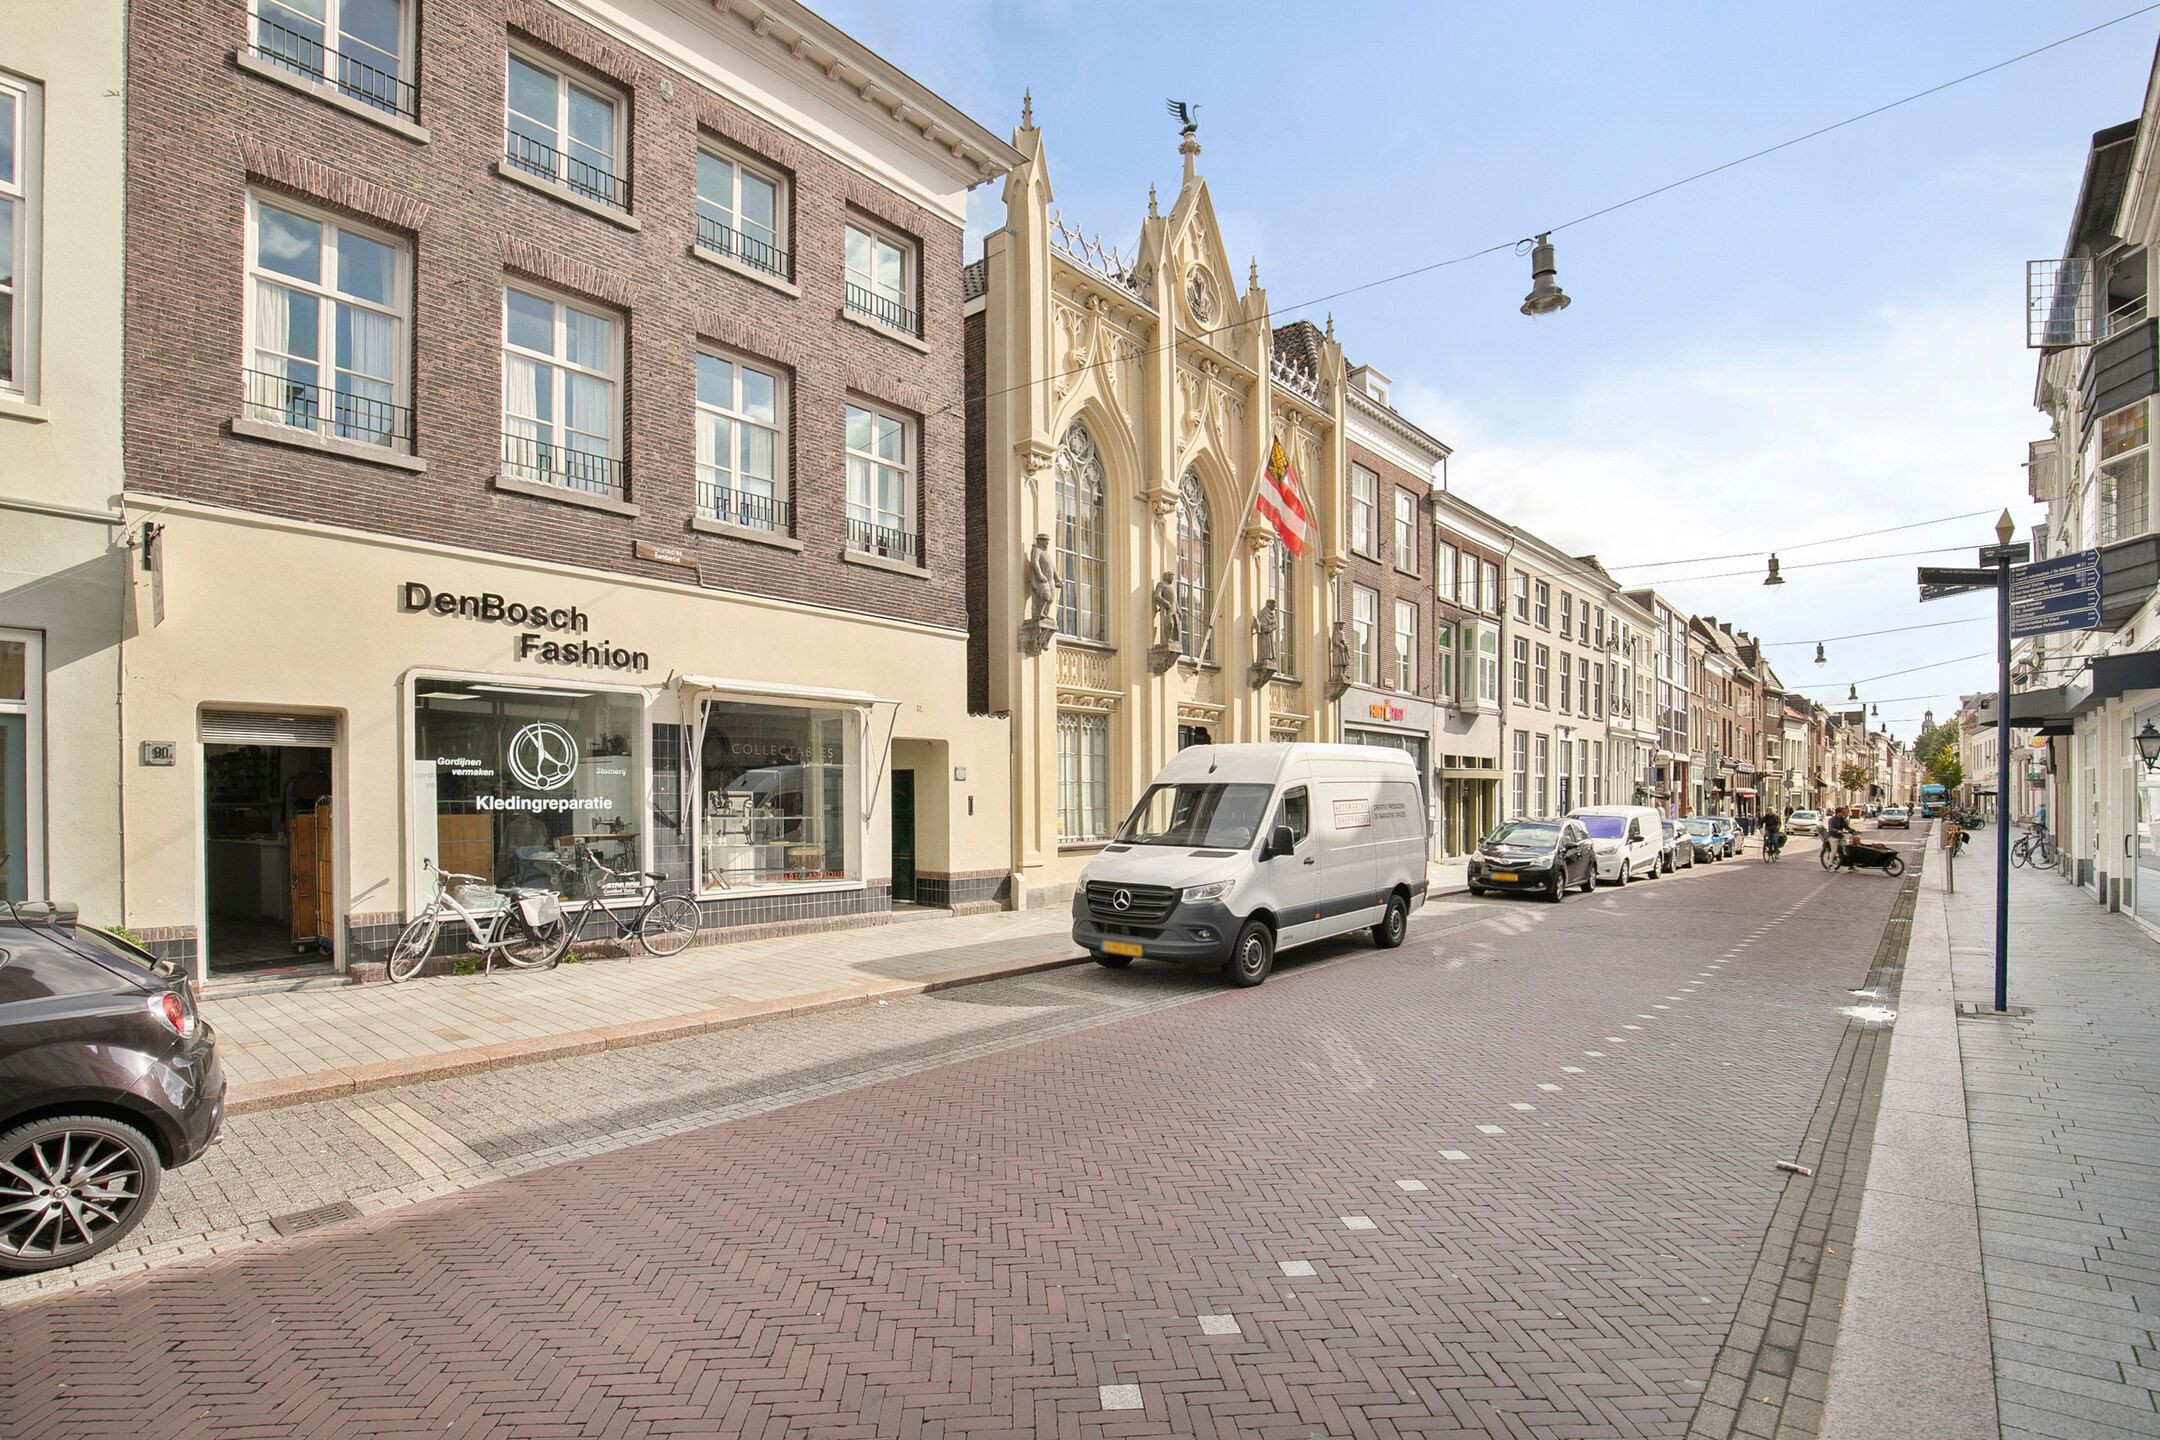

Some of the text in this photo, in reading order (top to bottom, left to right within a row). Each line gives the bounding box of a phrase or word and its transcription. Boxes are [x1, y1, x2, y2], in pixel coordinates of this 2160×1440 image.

[405, 581, 589, 632] DenBosch
[520, 633, 649, 670] Fashion
[731, 743, 834, 759] COLLECTABES
[437, 756, 482, 767] Gordijnen
[451, 767, 495, 777] vermaken
[595, 767, 627, 776] Stomerij
[476, 795, 613, 813] Kledingreparatie
